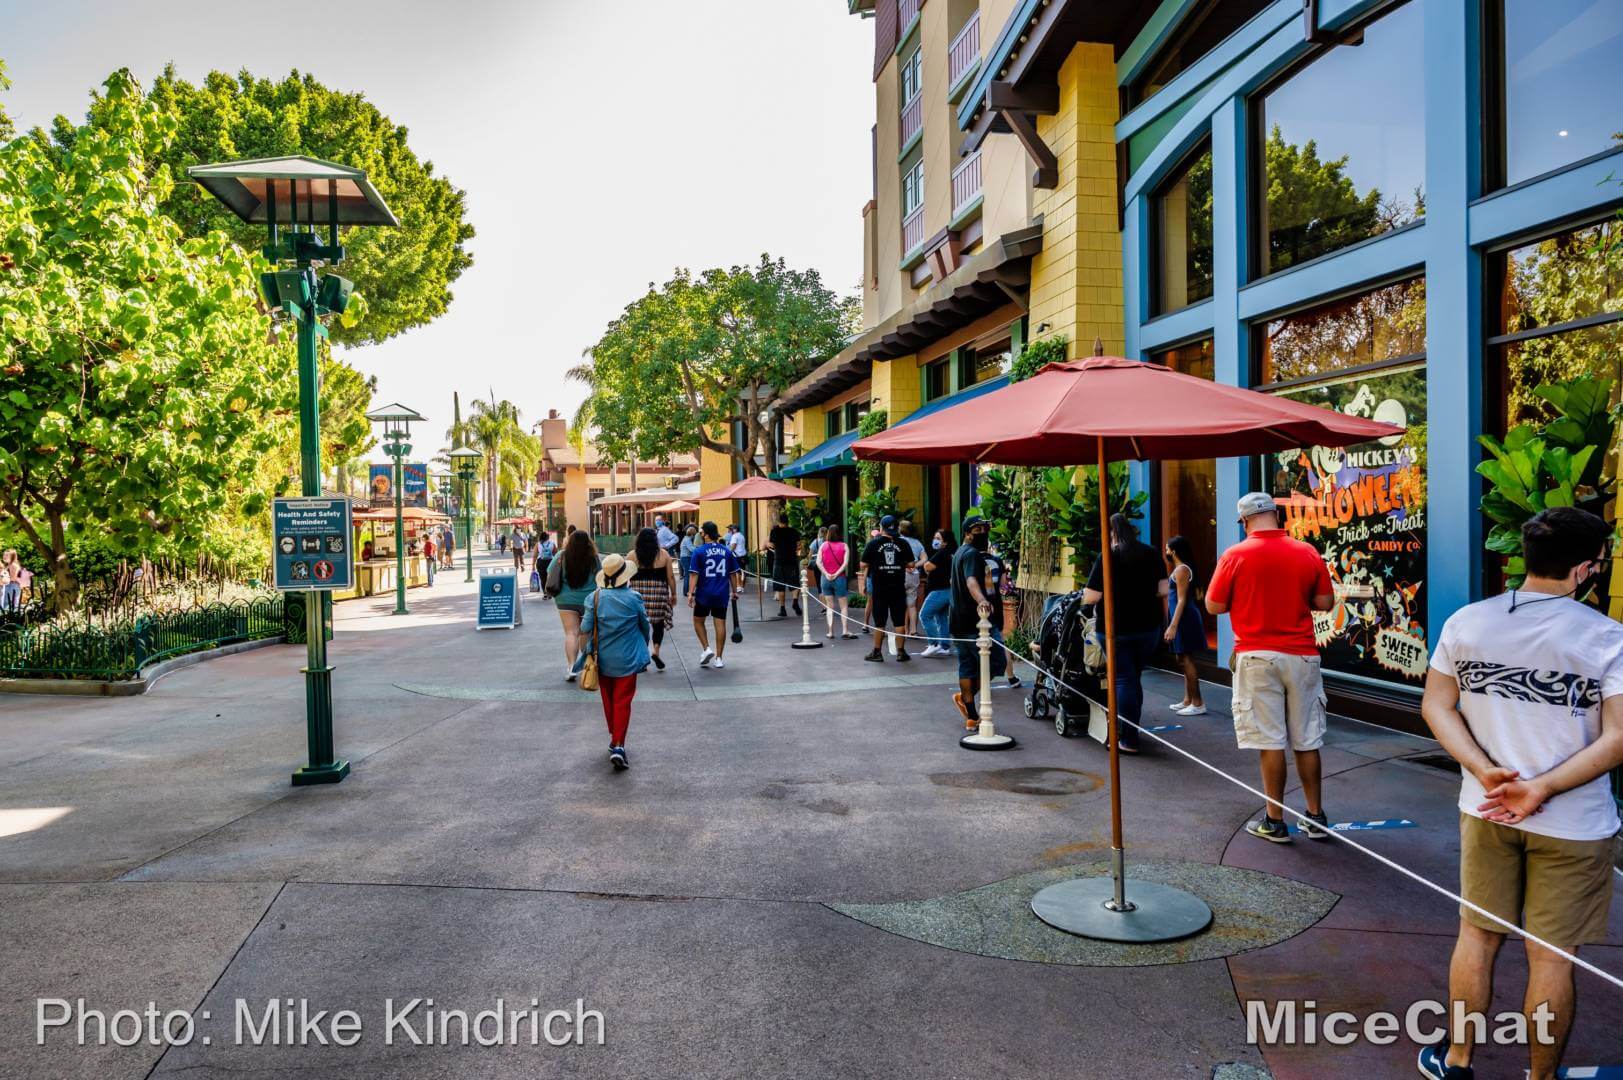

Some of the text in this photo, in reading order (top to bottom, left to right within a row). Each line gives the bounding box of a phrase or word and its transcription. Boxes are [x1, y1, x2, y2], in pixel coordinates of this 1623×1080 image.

[1346, 447, 1418, 468] MICKEY'S
[1284, 465, 1421, 538] HALLOWEEN
[1337, 520, 1370, 545] Trick
[1386, 508, 1425, 535] Treat
[705, 547, 727, 557] JASMIN
[1368, 540, 1404, 552] CANDY
[704, 558, 727, 577] 24
[1314, 620, 1330, 635] ISES
[1381, 634, 1422, 661] SWEET
[1385, 651, 1412, 668] SCARES
